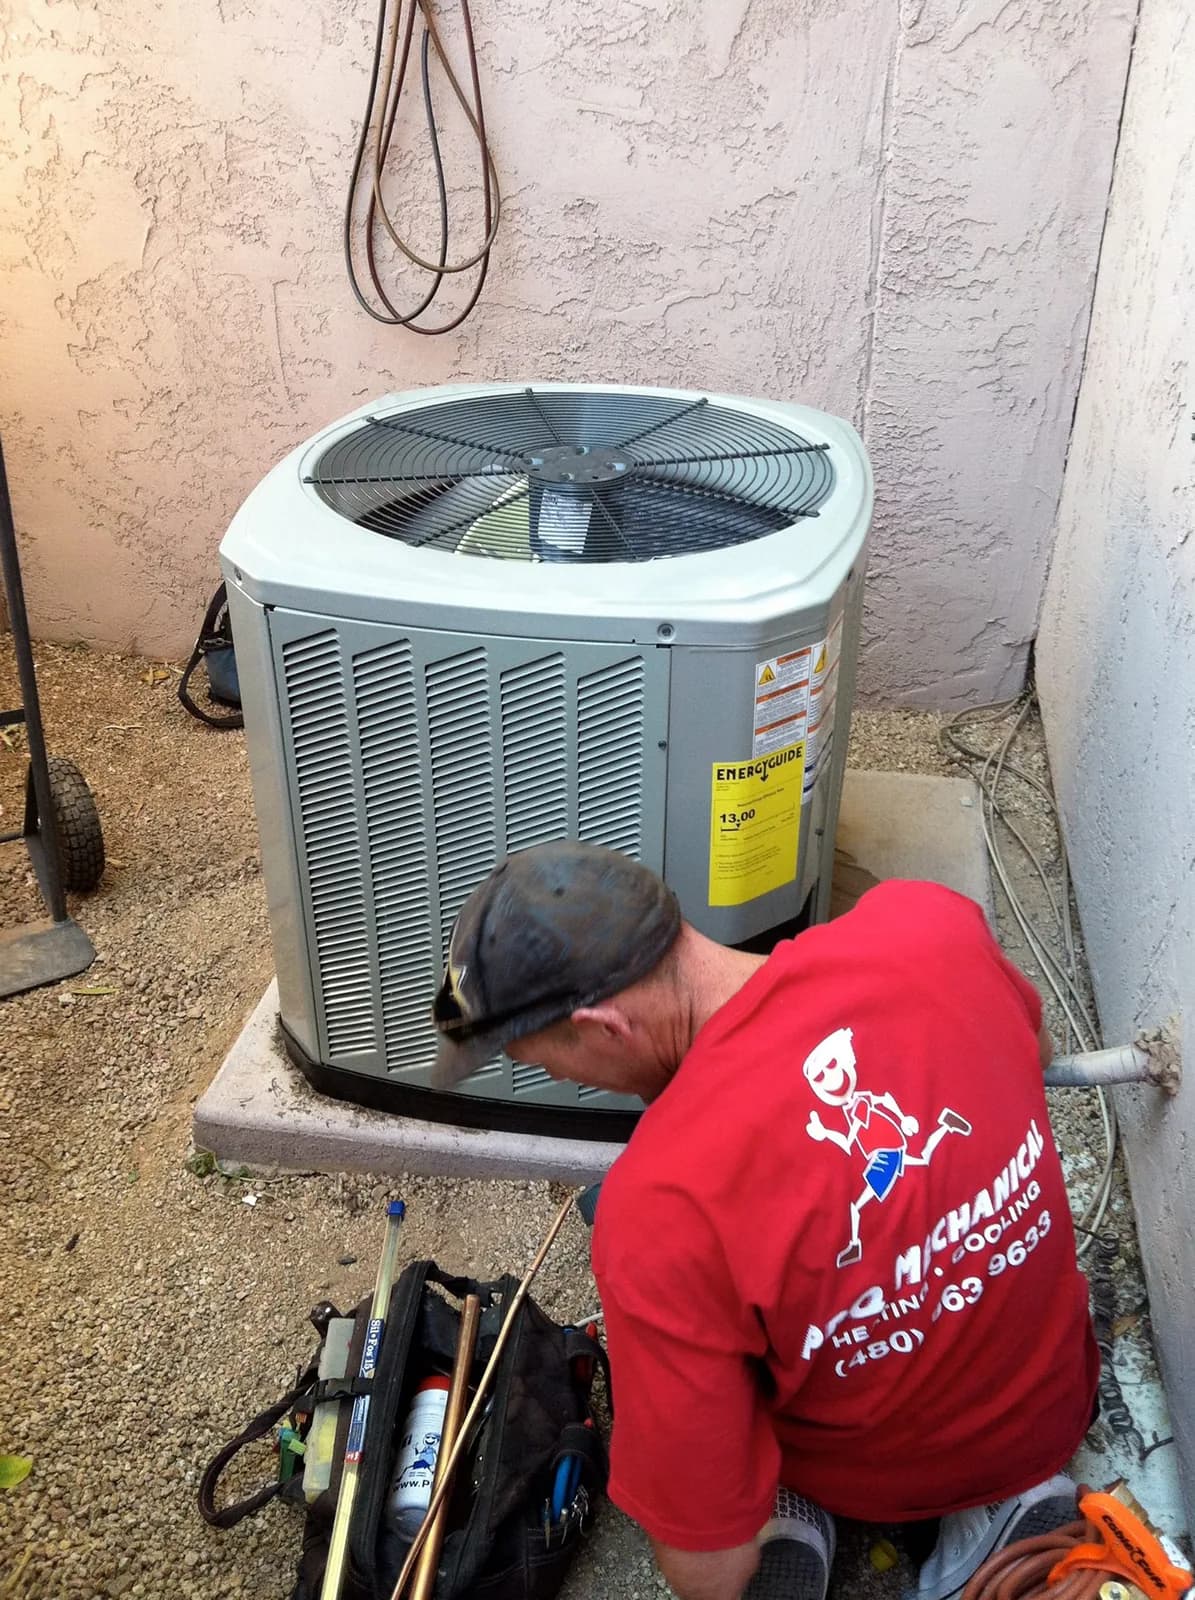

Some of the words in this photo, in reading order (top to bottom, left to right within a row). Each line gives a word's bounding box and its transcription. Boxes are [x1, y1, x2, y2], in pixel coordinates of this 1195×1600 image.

[717, 746, 803, 782] ENERGYGUIDE
[720, 809, 756, 824] 13.00
[835, 1328, 925, 1378] (480)
[931, 1276, 984, 1323] 63
[988, 1209, 1051, 1277] 9633
